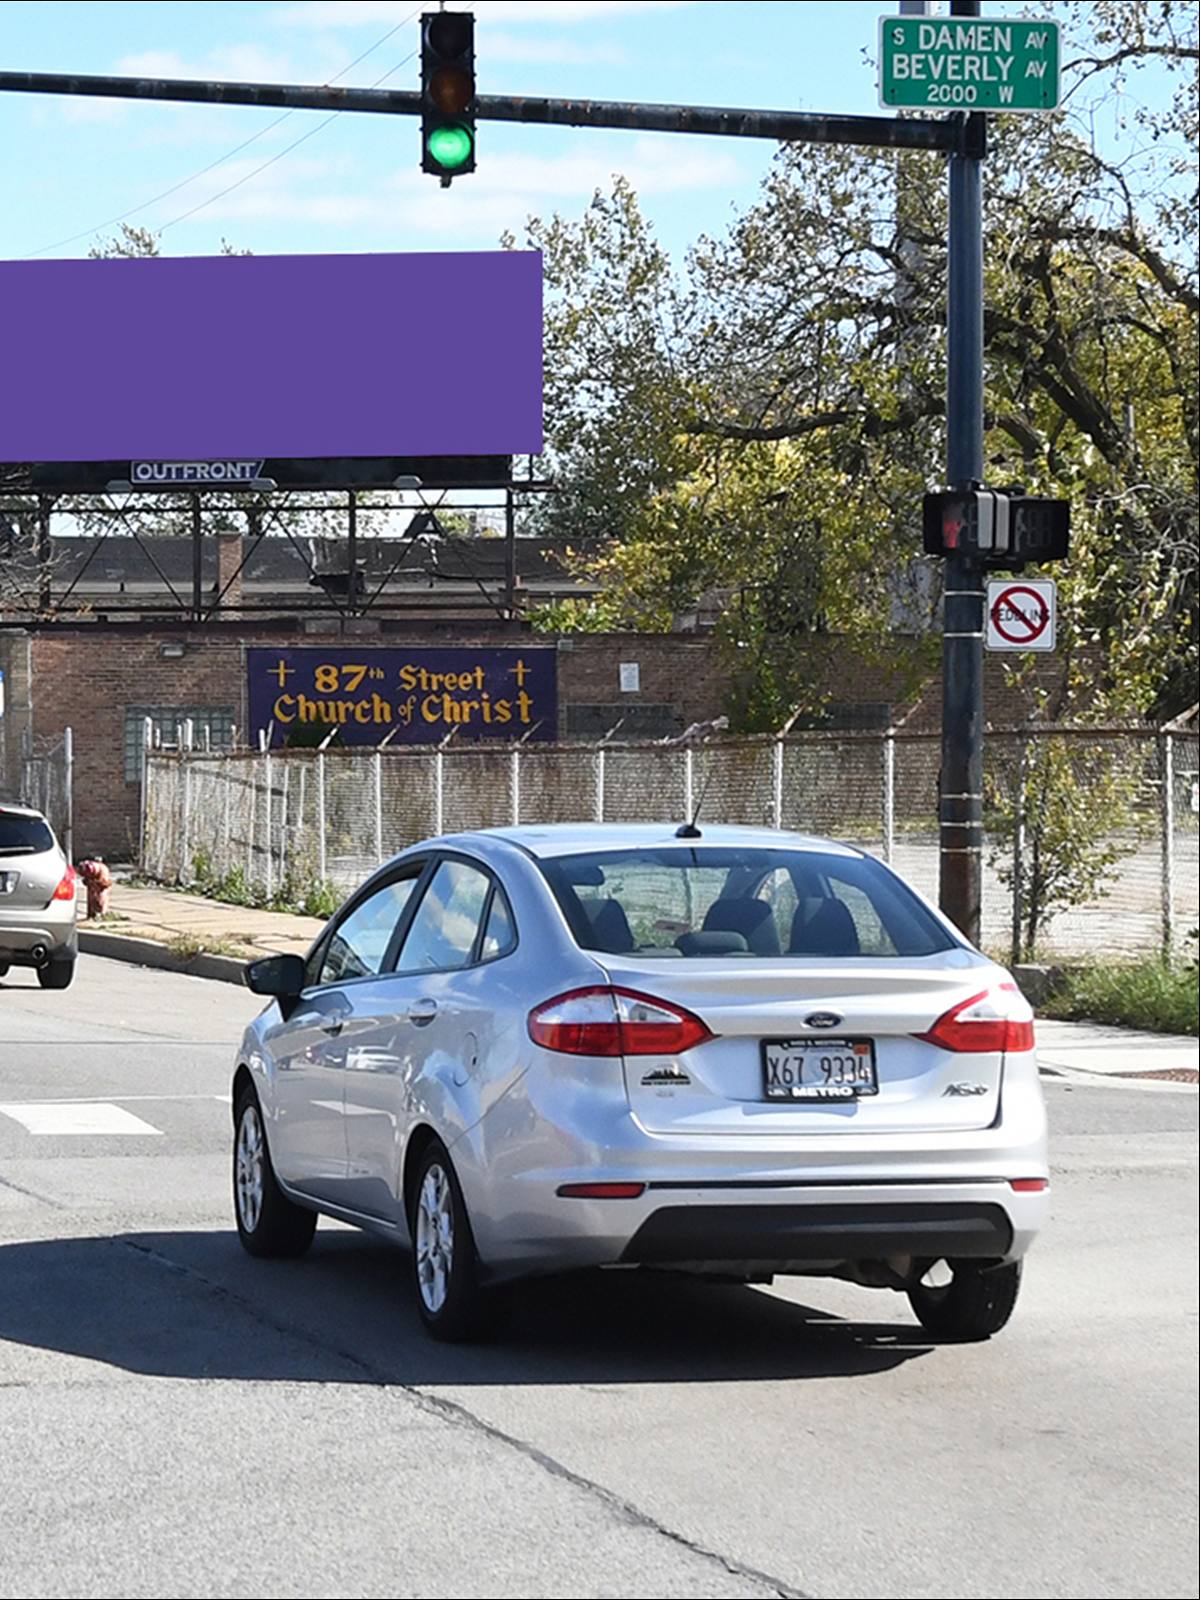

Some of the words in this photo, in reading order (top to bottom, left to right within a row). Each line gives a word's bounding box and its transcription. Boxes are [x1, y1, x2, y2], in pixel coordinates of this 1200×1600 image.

[893, 28, 905, 45] S
[919, 25, 1011, 51] DAMEN
[1025, 32, 1049, 49] AV
[893, 53, 1014, 81] BEVERLY
[1025, 61, 1048, 78] AV
[927, 84, 977, 103] 2000
[998, 86, 1014, 103] W
[136, 462, 256, 479] OUTFRONT
[314, 664, 385, 693] 87th
[398, 664, 485, 691] Street
[274, 693, 392, 723] Church
[399, 695, 416, 725] of
[421, 691, 533, 723] Christ
[768, 1057, 804, 1084] X67
[821, 1057, 870, 1084] 9334
[792, 1087, 853, 1097] METRO
